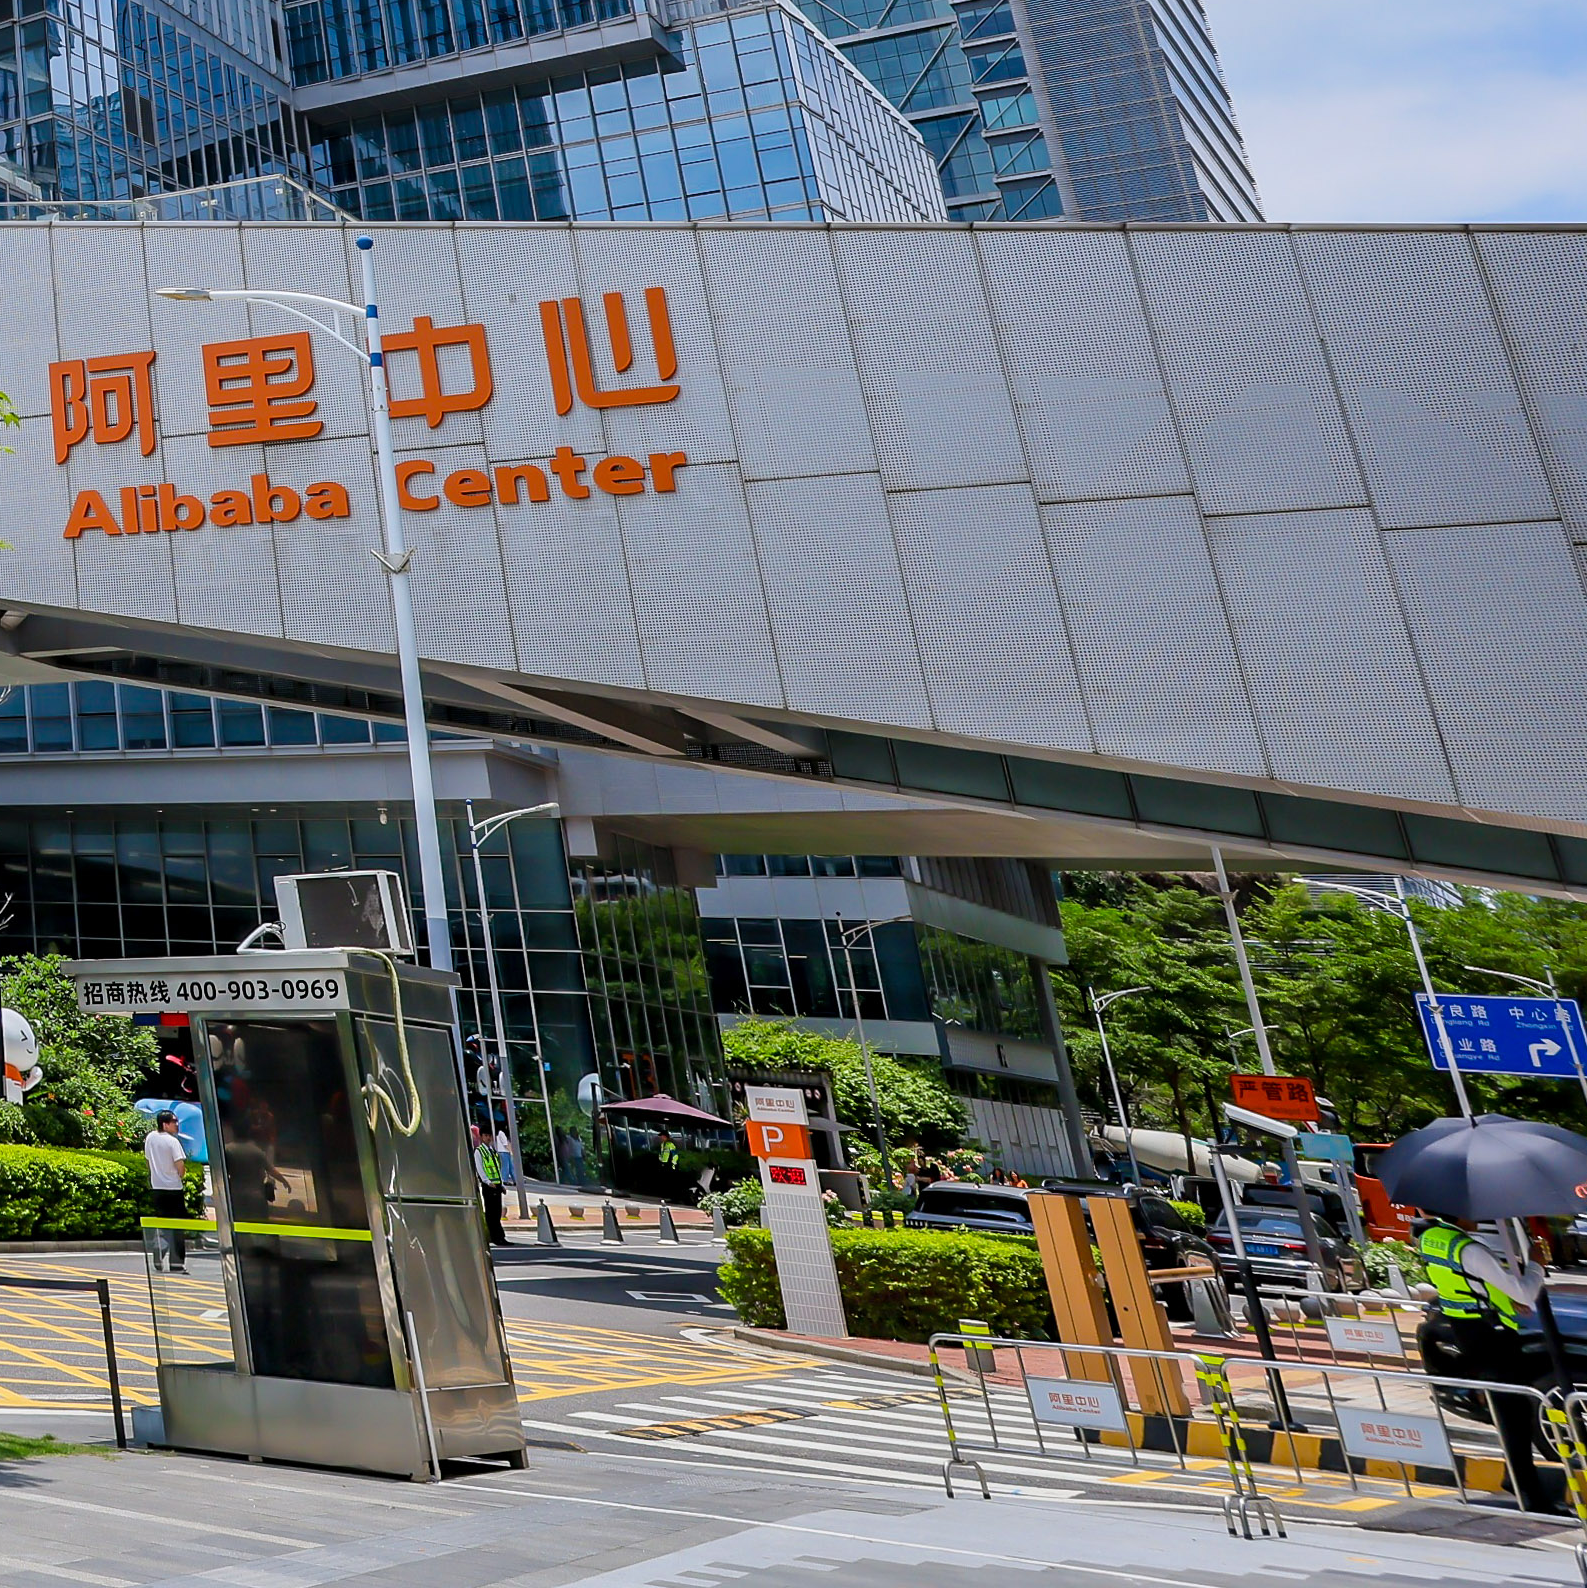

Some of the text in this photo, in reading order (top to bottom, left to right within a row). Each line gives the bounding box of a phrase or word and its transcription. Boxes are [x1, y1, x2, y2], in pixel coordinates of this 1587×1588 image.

[49, 286, 681, 465] 阿里中心
[63, 446, 687, 539] Alibaba Center
[83, 979, 339, 1006] 招商热线 400-903-0969
[1509, 1006, 1571, 1023] 中心路
[1440, 1052, 1483, 1061] Cuangye
[1238, 1080, 1309, 1102] 严管路
[755, 1097, 795, 1109] 阿里中心
[761, 1125, 784, 1152] P
[1344, 1328, 1384, 1339] 阿里中心
[1048, 1392, 1099, 1408] 阿里中心
[1361, 1422, 1422, 1442] 阿里中心
